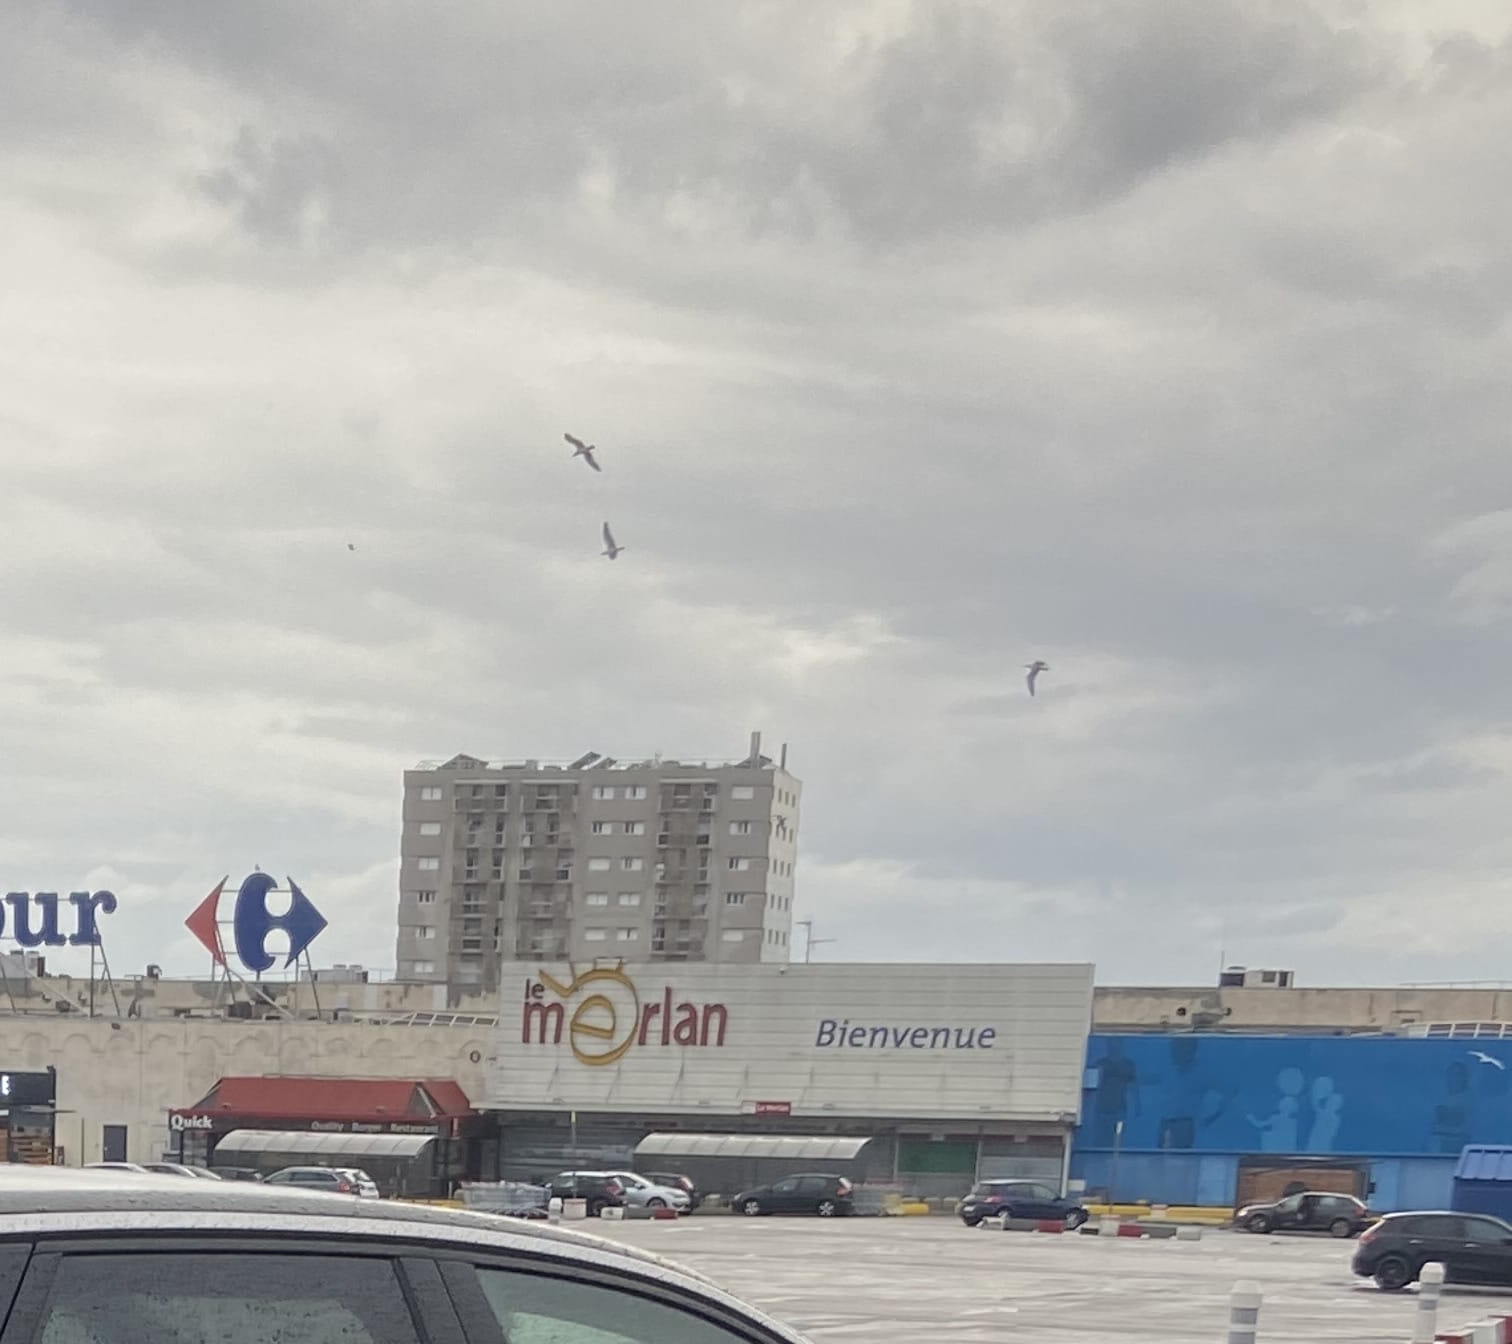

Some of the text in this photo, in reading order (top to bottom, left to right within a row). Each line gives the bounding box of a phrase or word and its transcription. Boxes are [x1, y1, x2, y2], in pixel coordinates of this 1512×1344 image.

[524, 978, 545, 1000] le
[522, 969, 728, 1066] merlan
[815, 1019, 997, 1049] Bienvenue
[171, 1114, 213, 1131] Quick
